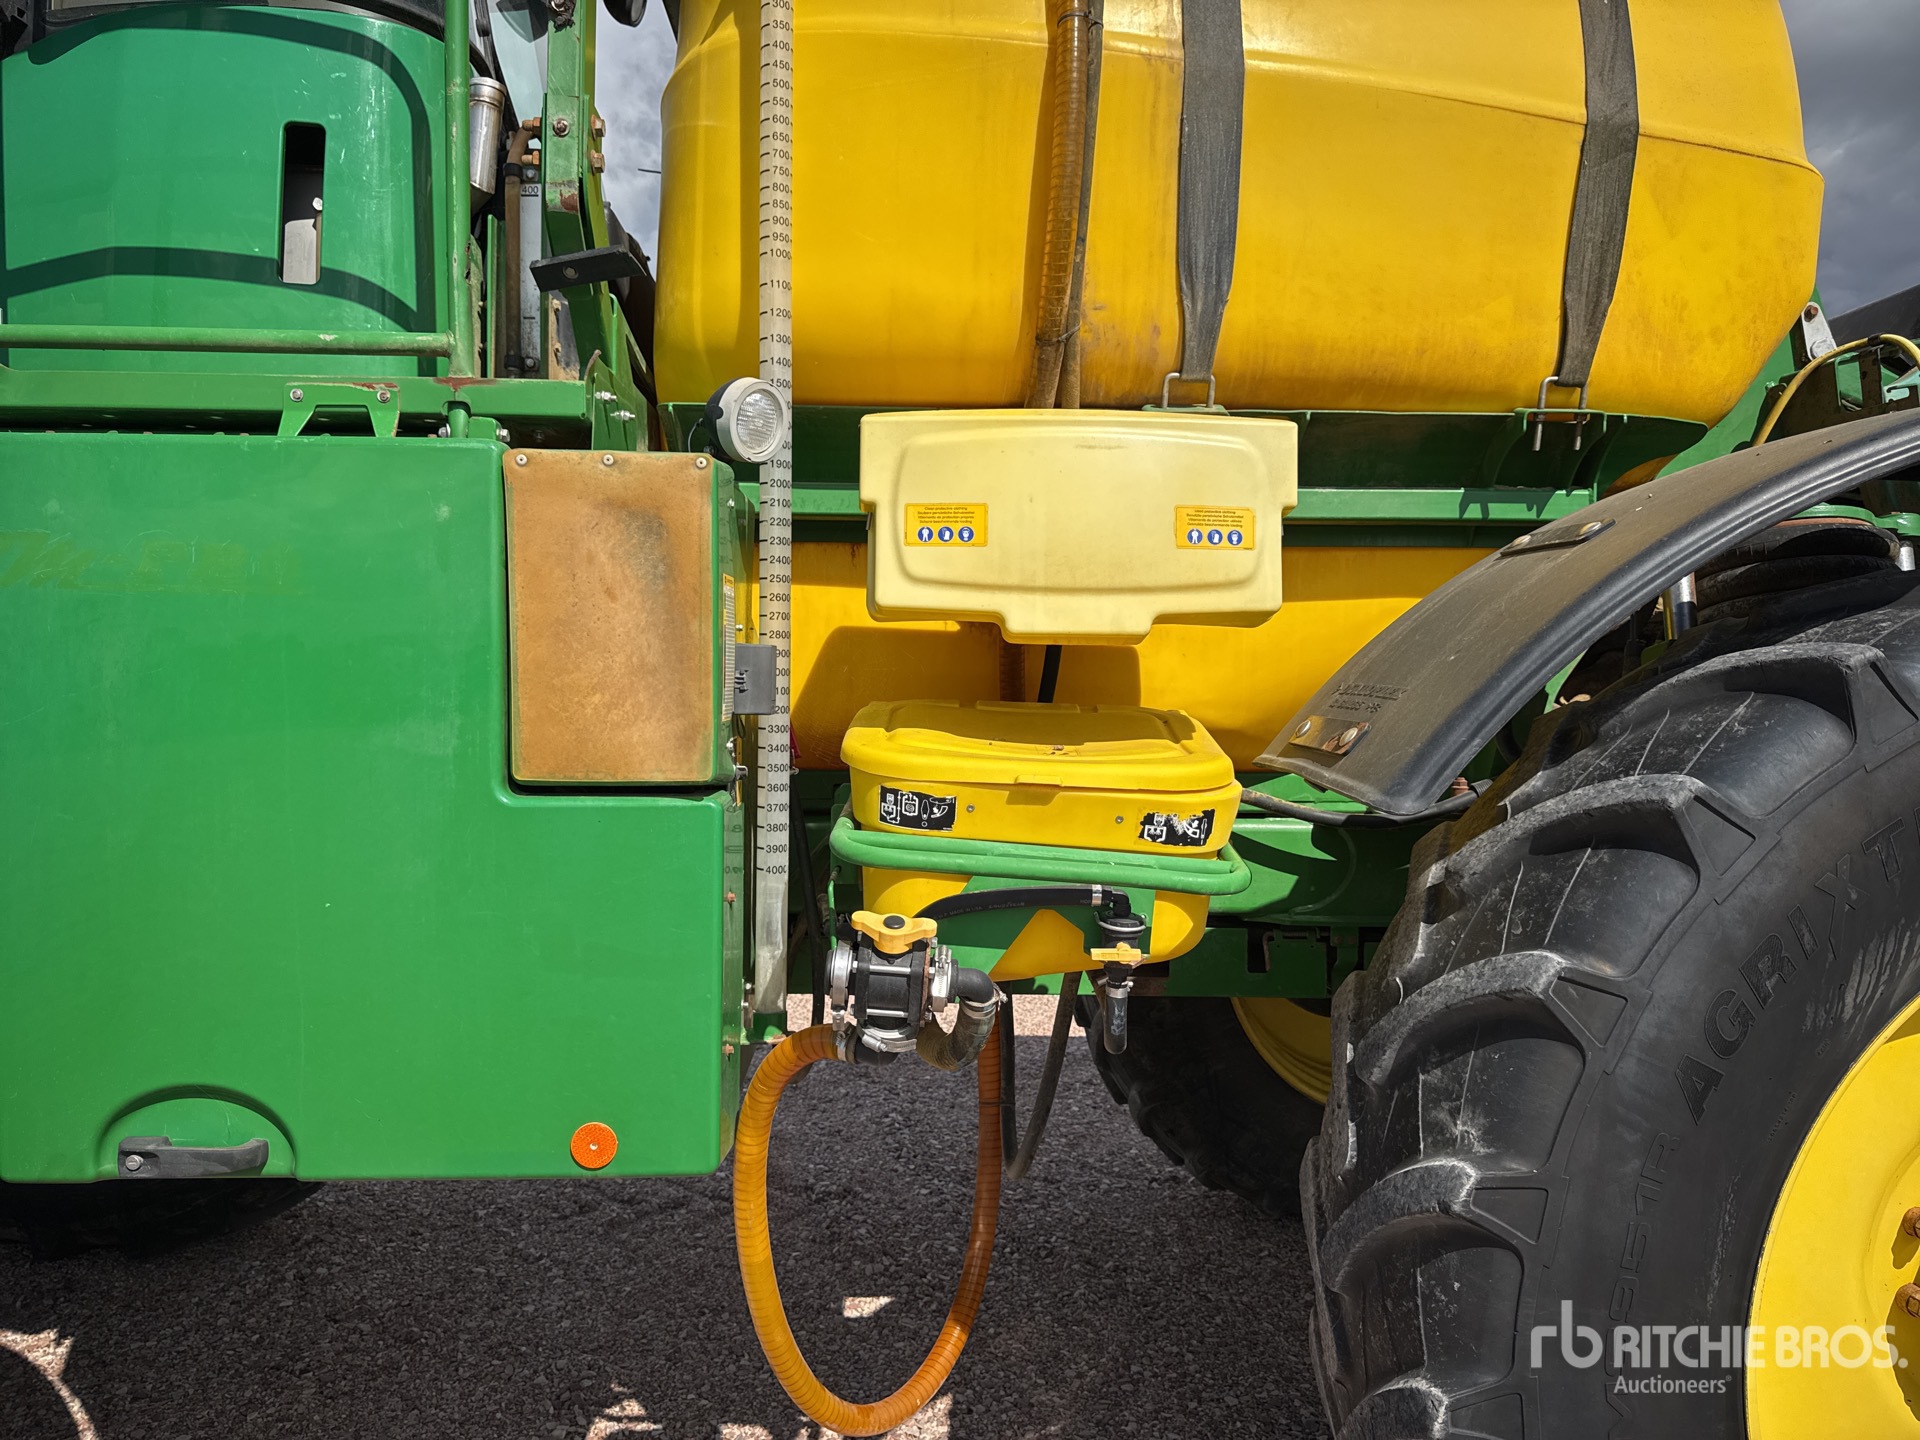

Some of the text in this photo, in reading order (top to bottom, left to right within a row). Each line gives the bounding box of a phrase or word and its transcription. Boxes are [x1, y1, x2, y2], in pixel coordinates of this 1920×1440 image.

[772, 0, 790, 10] 300
[772, 20, 790, 31] 350
[772, 40, 790, 51] 400
[772, 60, 790, 71] 450
[772, 78, 790, 90] 500
[772, 97, 790, 108] 550
[772, 114, 790, 126] 600
[772, 131, 790, 143] 650
[772, 149, 790, 160] 700
[772, 165, 790, 177] 750
[521, 185, 538, 194] 400
[772, 182, 790, 194] 800
[772, 199, 790, 210] 850
[772, 215, 790, 227] 900
[772, 232, 790, 243] 950
[770, 248, 791, 260] 1000
[770, 279, 791, 291] 1100
[770, 307, 791, 319] 1200
[770, 333, 791, 345] 1300
[770, 356, 791, 368] 1400
[770, 460, 791, 469] 1900
[770, 478, 791, 489] 2000
[770, 498, 791, 508] 2100
[770, 517, 791, 527] 2200
[770, 536, 791, 546] 2300
[769, 555, 791, 565] 2400
[769, 574, 791, 583] 2500
[769, 593, 790, 602] 2600
[769, 611, 790, 621] 2700
[769, 630, 790, 639] 2800
[768, 724, 789, 733] 3300
[767, 744, 789, 752] 3400
[767, 763, 788, 772] 3500
[767, 783, 788, 792] 3600
[766, 803, 788, 812] 3700
[766, 823, 787, 832] 3800
[766, 844, 787, 853] 3900
[765, 865, 787, 874] 4000
[1675, 806, 1920, 1127] AGRIXT
